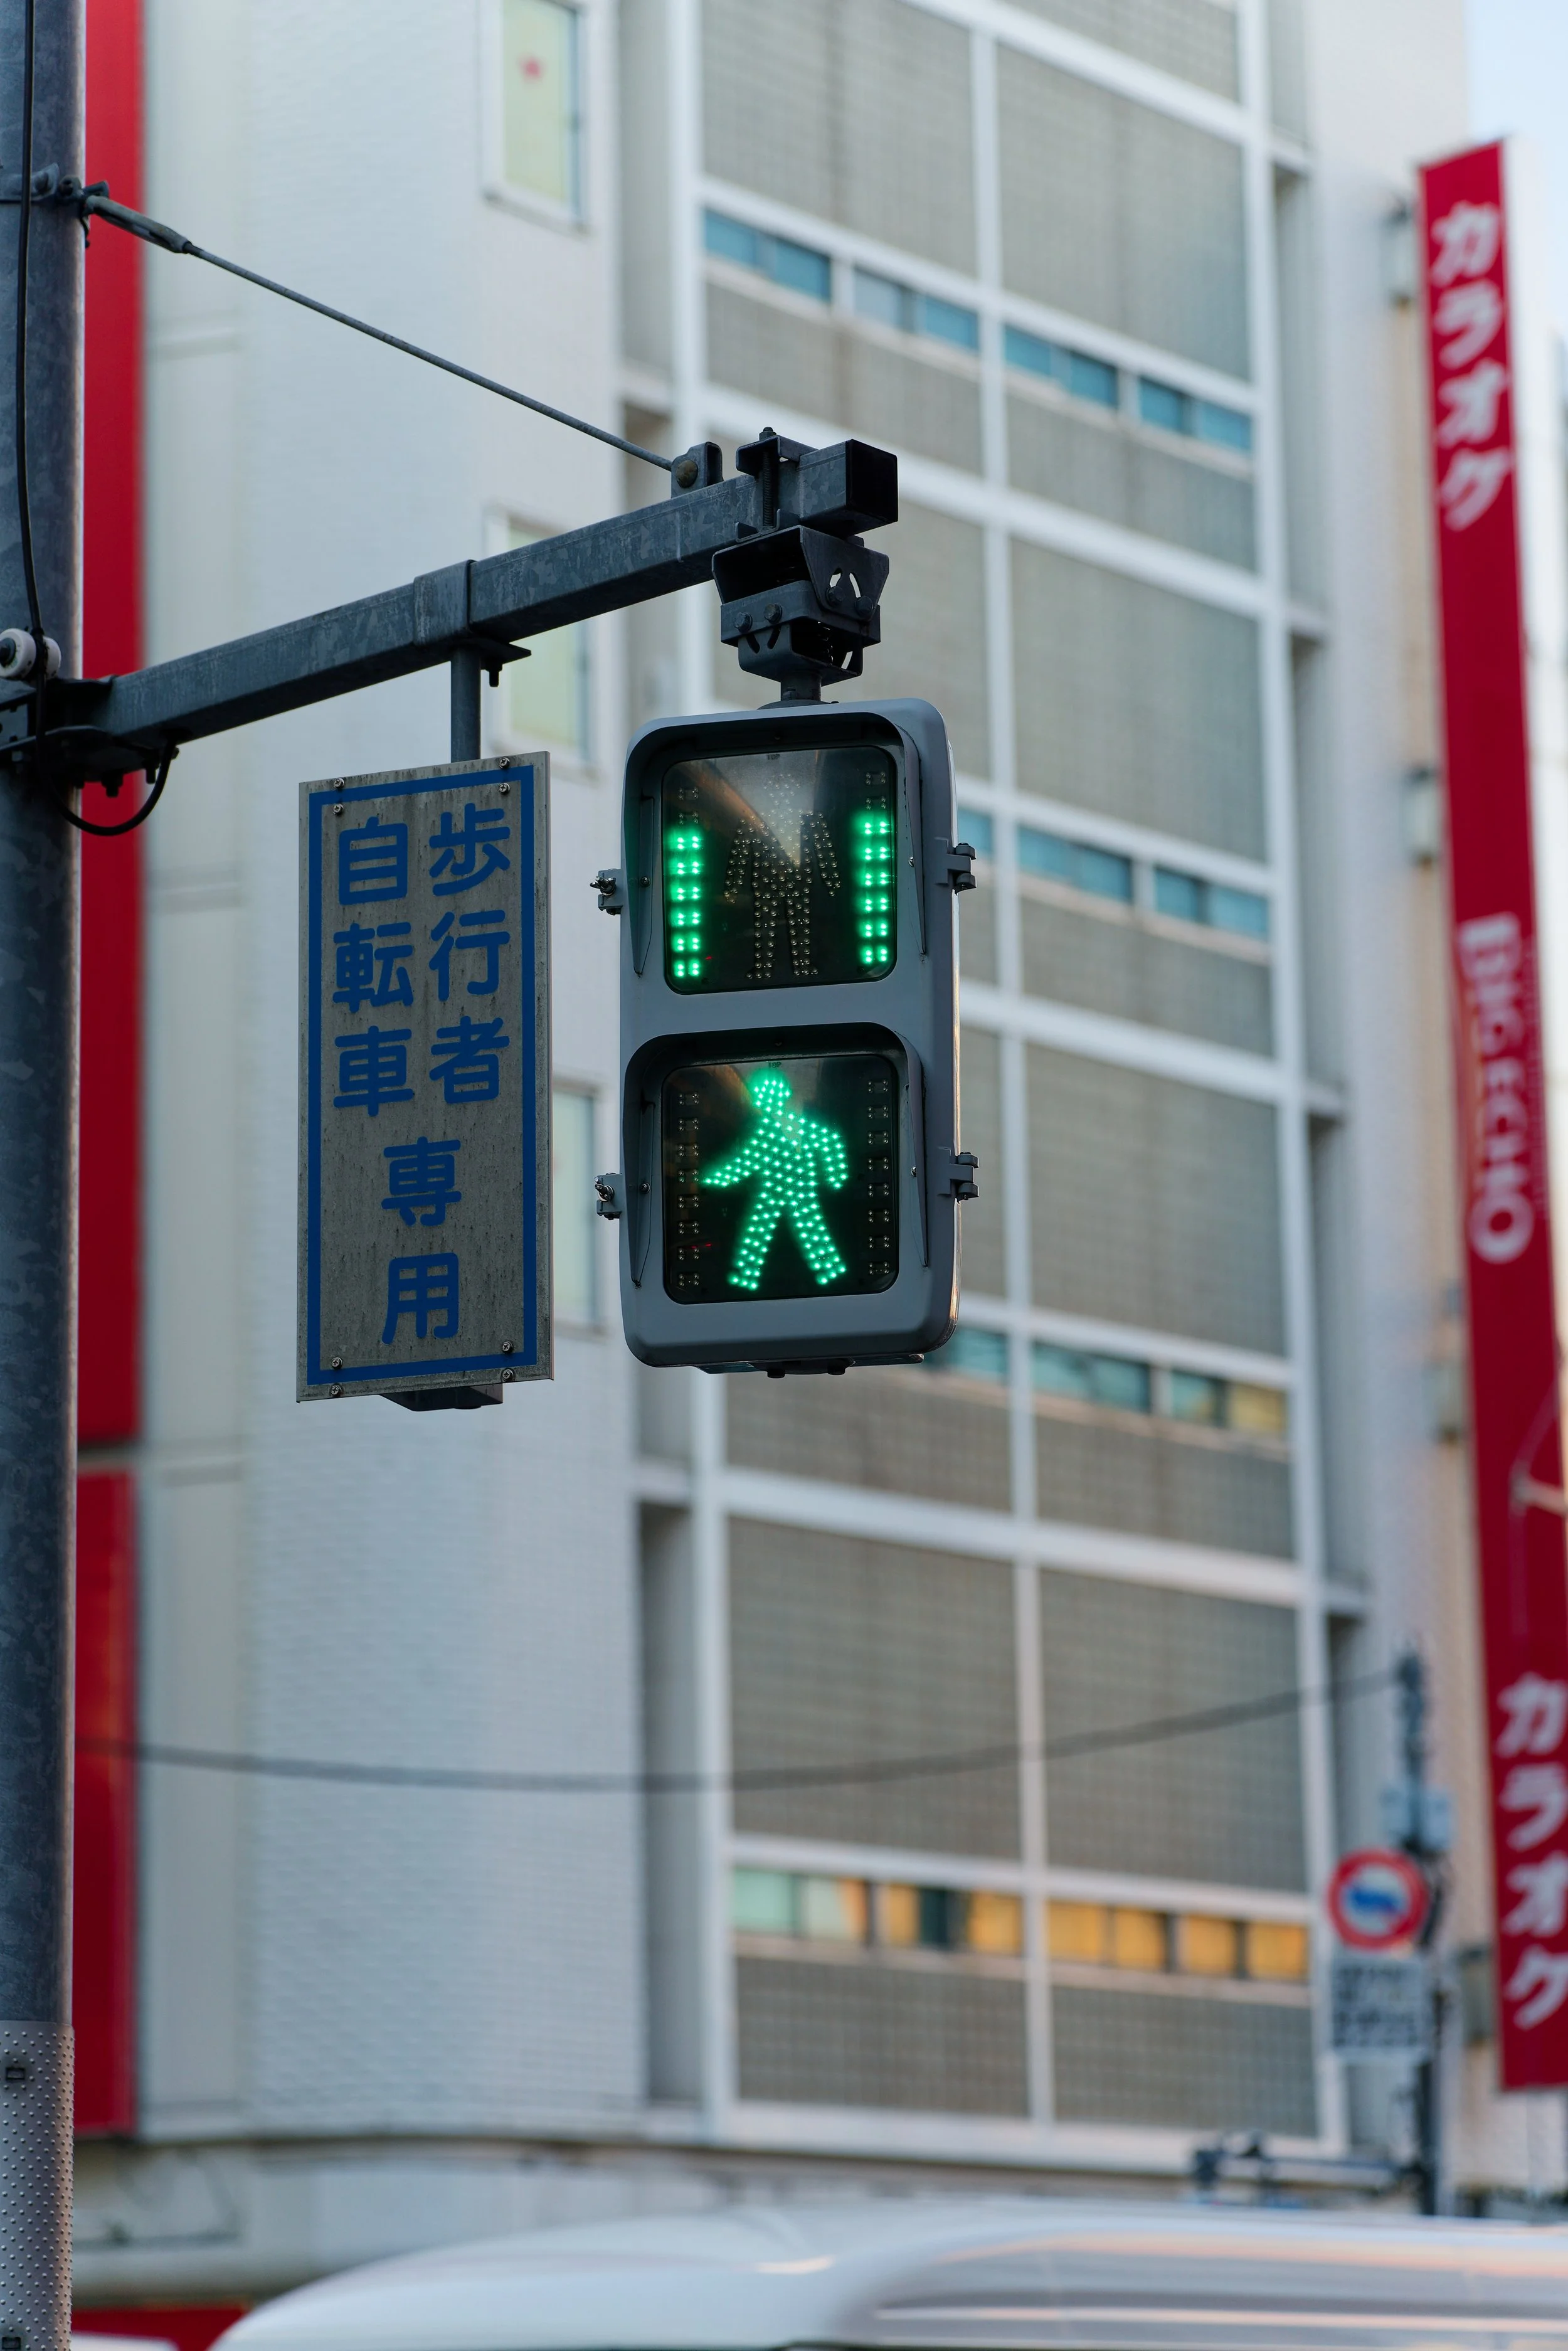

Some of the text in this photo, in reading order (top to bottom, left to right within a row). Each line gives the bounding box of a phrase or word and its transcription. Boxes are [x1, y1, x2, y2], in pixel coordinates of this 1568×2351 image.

[1431, 199, 1512, 531] カラオケ
[333, 817, 415, 1116] 自転車
[428, 803, 511, 1105] 歩行者
[381, 1137, 462, 1344] 専用
[1498, 1672, 1568, 2030] カラオケ
